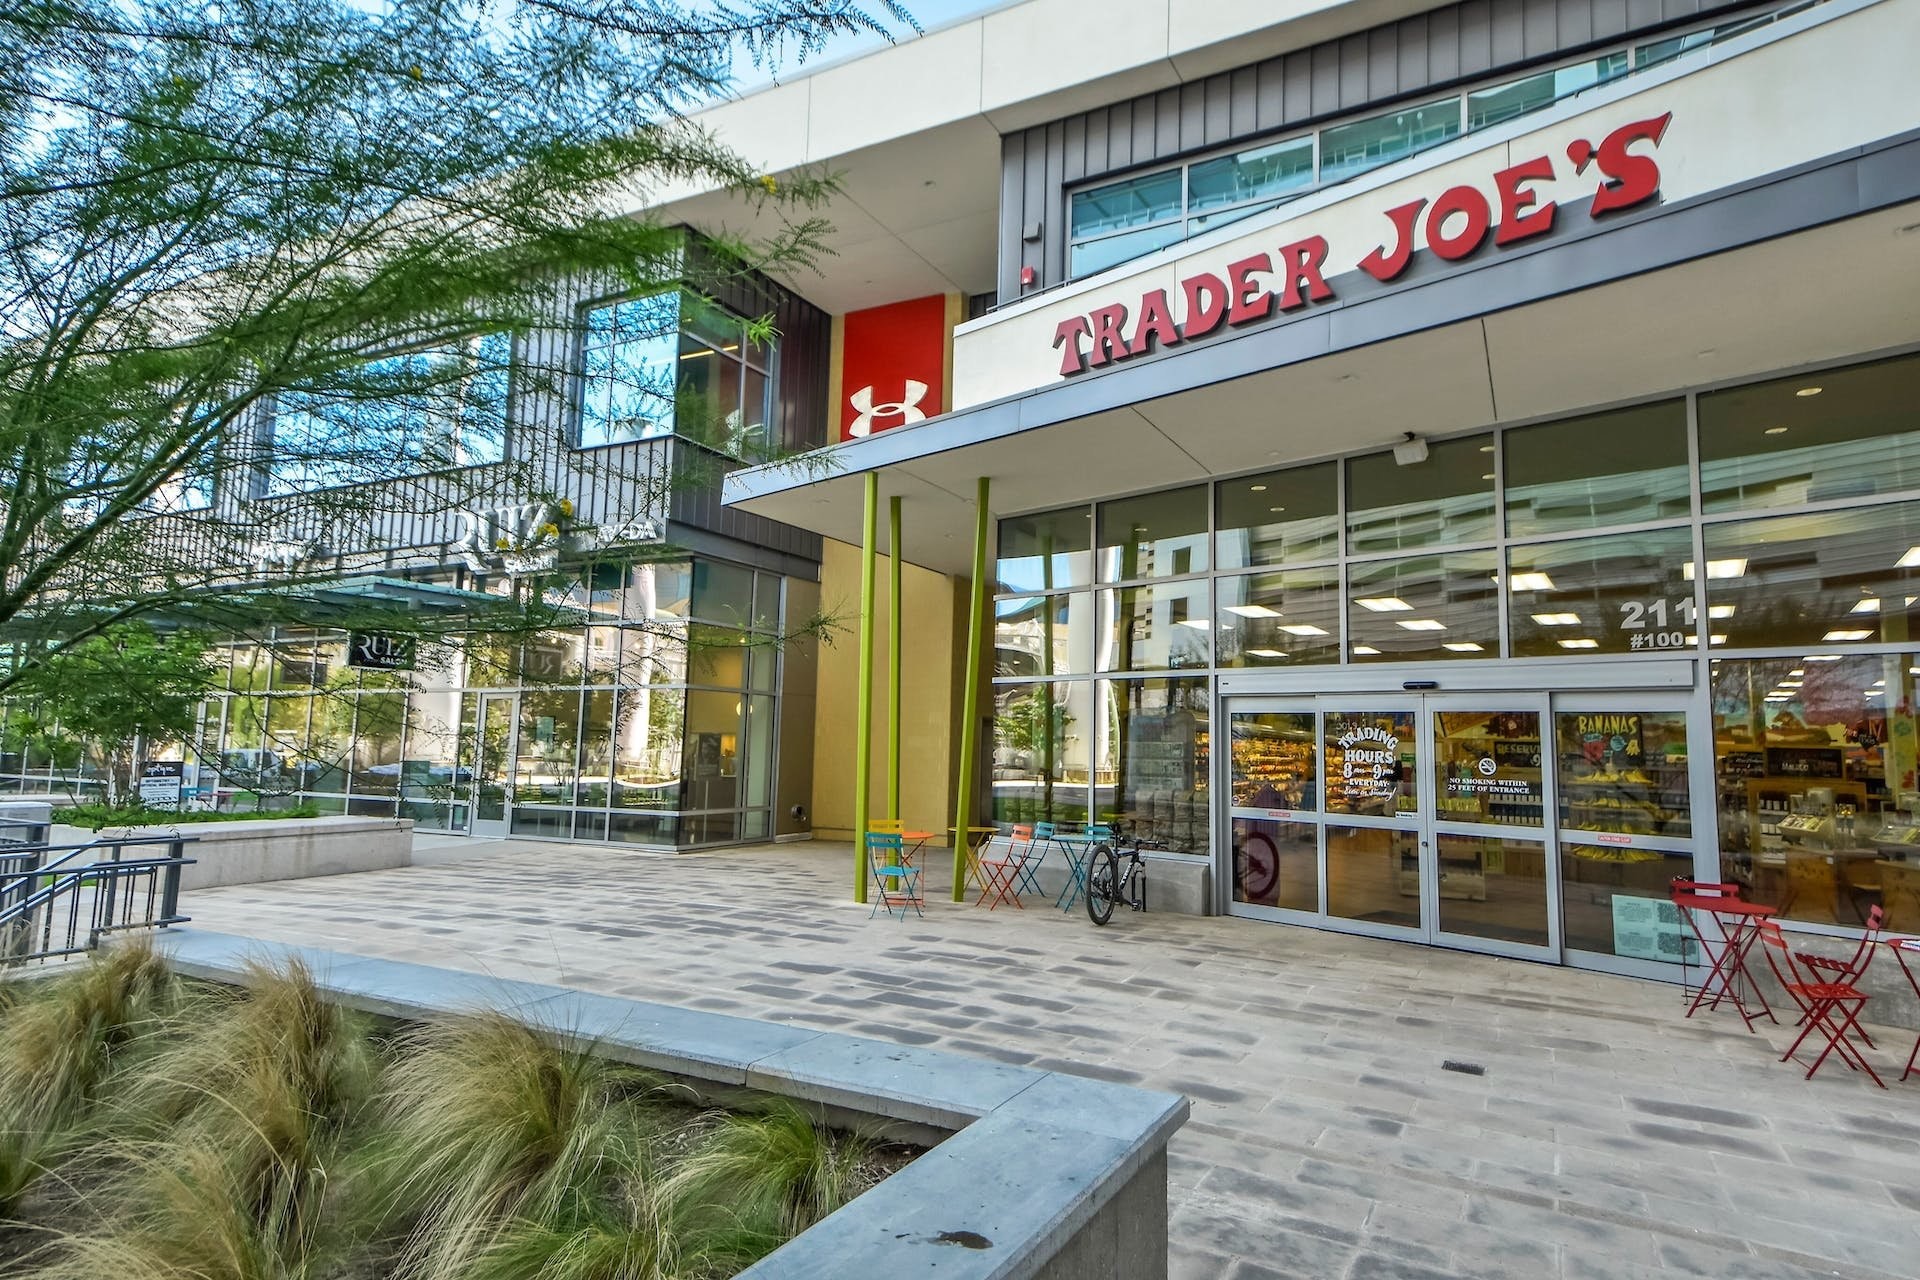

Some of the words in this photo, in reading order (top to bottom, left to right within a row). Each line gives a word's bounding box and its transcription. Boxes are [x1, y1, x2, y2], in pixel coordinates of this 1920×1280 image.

[1052, 234, 1334, 377] TRADER
[1358, 111, 1673, 282] JOE'S
[1620, 596, 1695, 629] 211
[1630, 632, 1684, 649] #100
[1578, 715, 1638, 734] BANANAS
[1338, 727, 1399, 750] TRADING
